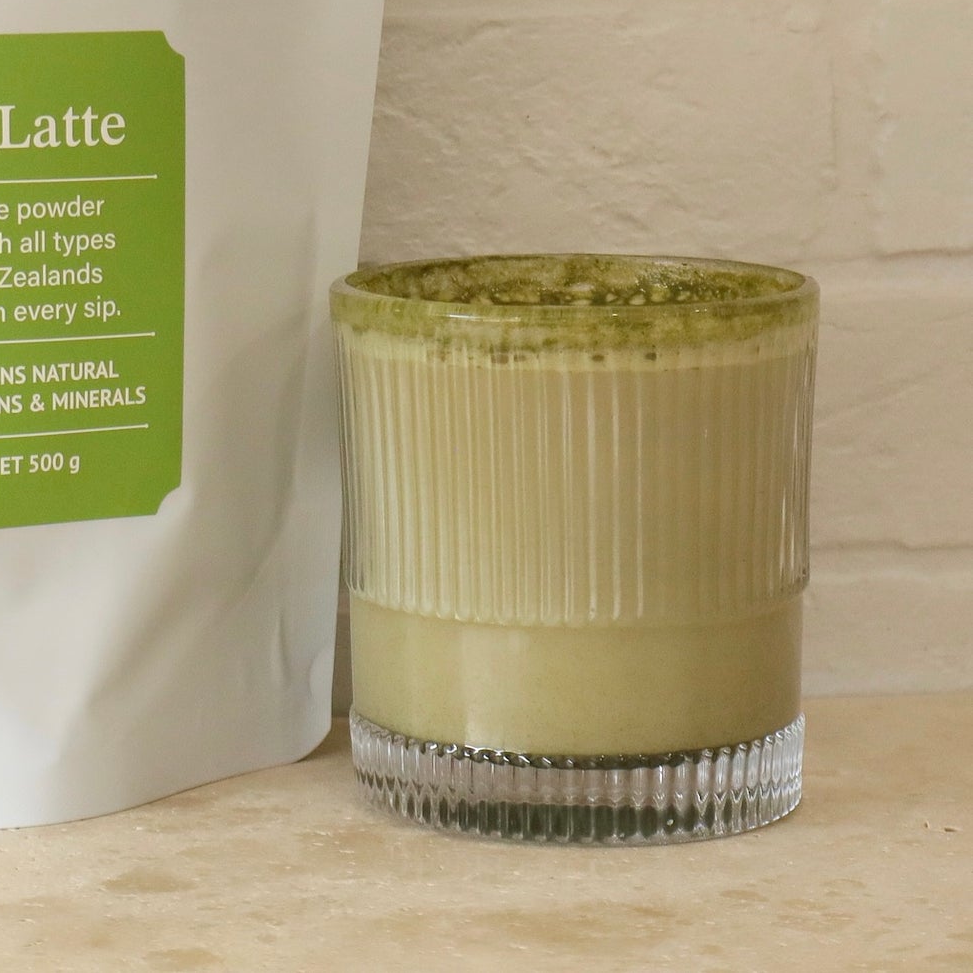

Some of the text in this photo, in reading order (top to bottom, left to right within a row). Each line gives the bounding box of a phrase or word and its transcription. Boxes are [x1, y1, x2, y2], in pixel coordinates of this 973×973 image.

[17, 194, 105, 225] powder
[19, 230, 46, 254] all
[52, 231, 116, 257] types
[13, 302, 77, 325] every
[83, 300, 121, 323] sip.
[32, 360, 120, 384] NATURAL
[29, 393, 45, 412] &
[52, 385, 146, 411] MINERALS
[29, 452, 64, 473] 500
[69, 455, 80, 474] g
